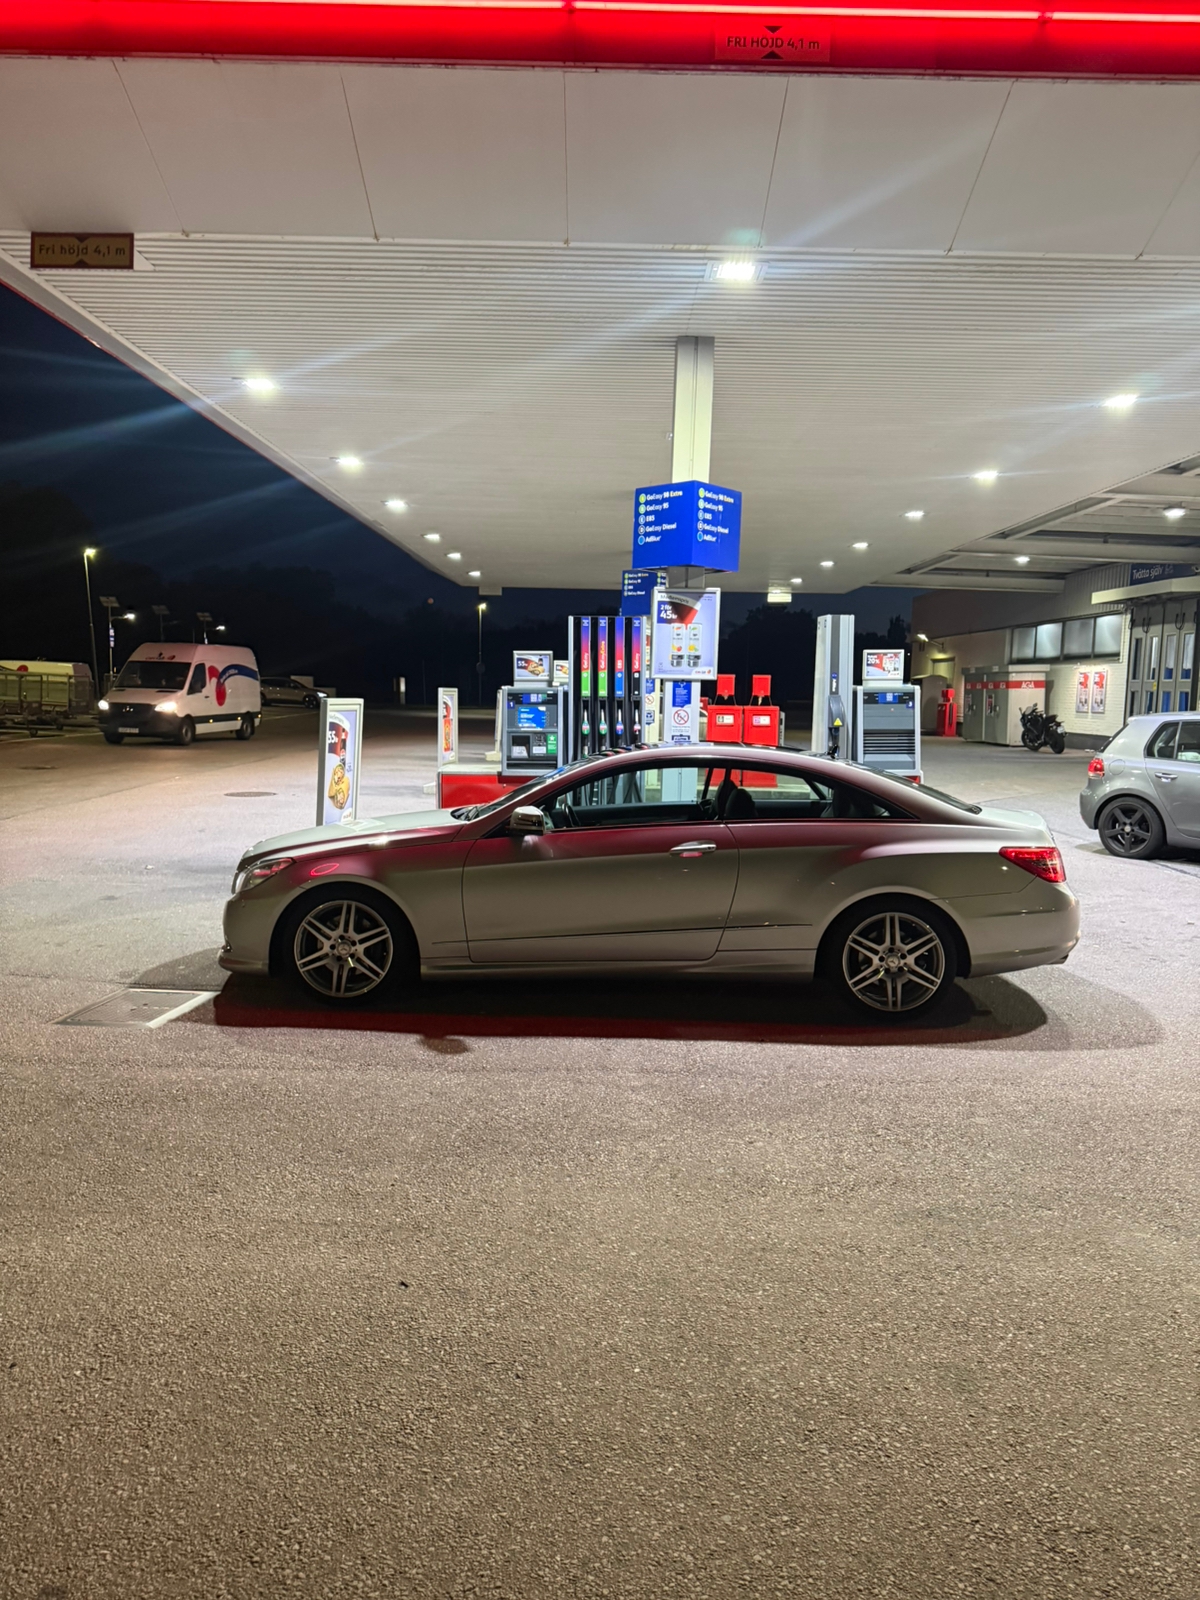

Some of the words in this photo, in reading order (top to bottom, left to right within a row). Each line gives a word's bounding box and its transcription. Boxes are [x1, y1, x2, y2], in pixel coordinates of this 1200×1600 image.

[727, 36, 746, 48] FRI
[750, 35, 784, 48] HÖJD
[787, 38, 804, 50] 4,1
[808, 41, 820, 49] m
[38, 244, 55, 254] Fri
[60, 244, 88, 257] höjd
[94, 245, 110, 258] 4,1
[116, 247, 126, 256] m
[1133, 569, 1150, 580] Tvätta
